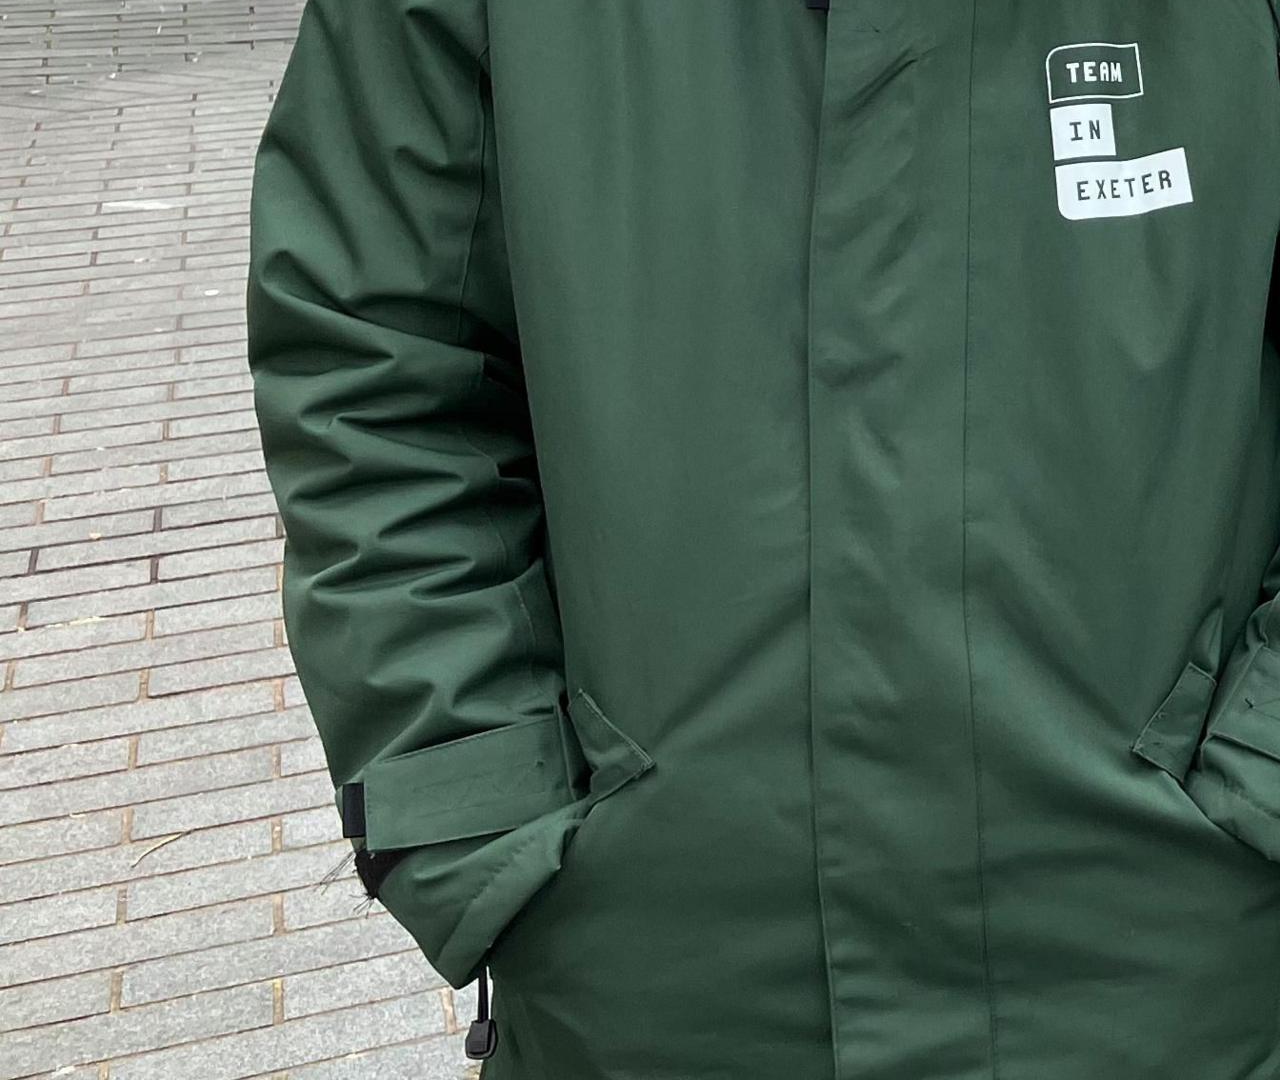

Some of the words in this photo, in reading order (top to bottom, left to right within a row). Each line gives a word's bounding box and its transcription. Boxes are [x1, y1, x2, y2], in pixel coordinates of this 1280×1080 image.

[1066, 61, 1123, 83] TEAM
[1069, 119, 1101, 141] IN
[1076, 169, 1172, 201] EXETER
